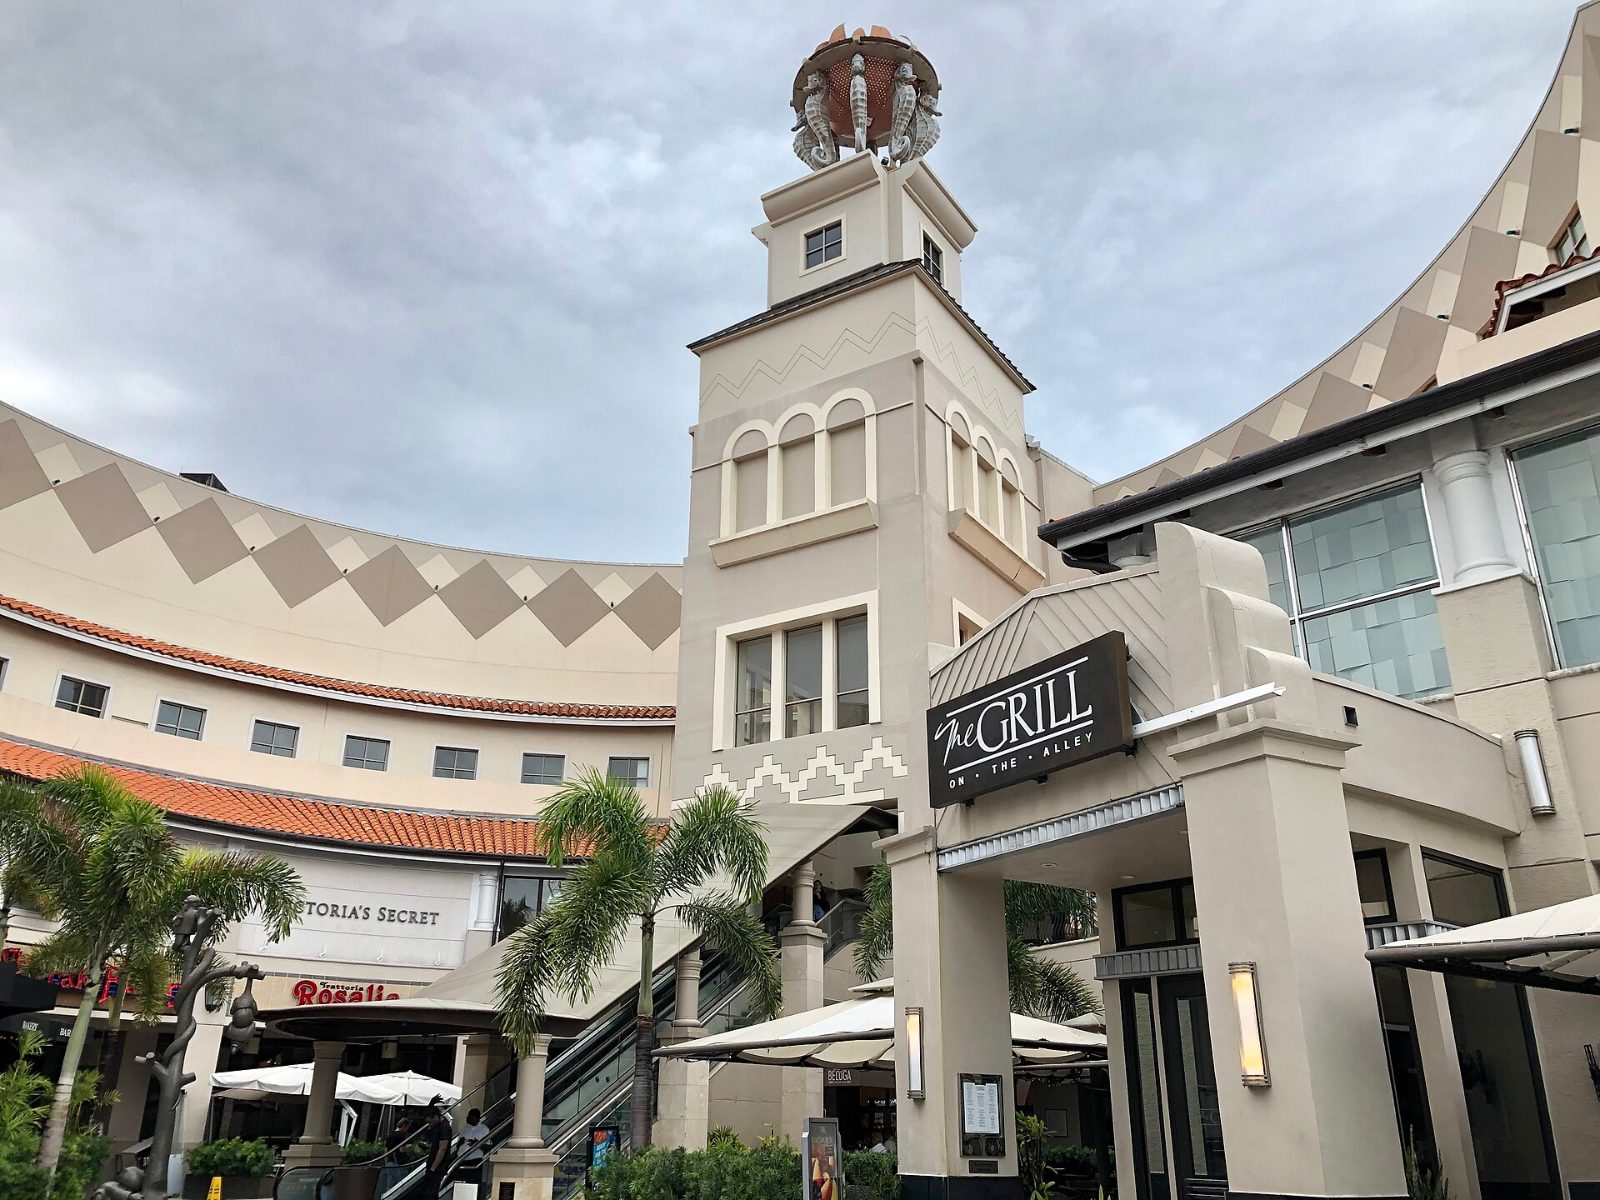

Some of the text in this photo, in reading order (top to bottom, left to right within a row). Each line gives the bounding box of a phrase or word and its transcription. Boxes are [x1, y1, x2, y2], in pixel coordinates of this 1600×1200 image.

[934, 669, 1093, 766] The GRILL
[949, 732, 1093, 789] ON THE ALLEY
[296, 901, 440, 925] TORIA'S SECRET
[320, 981, 364, 992] Trattoria
